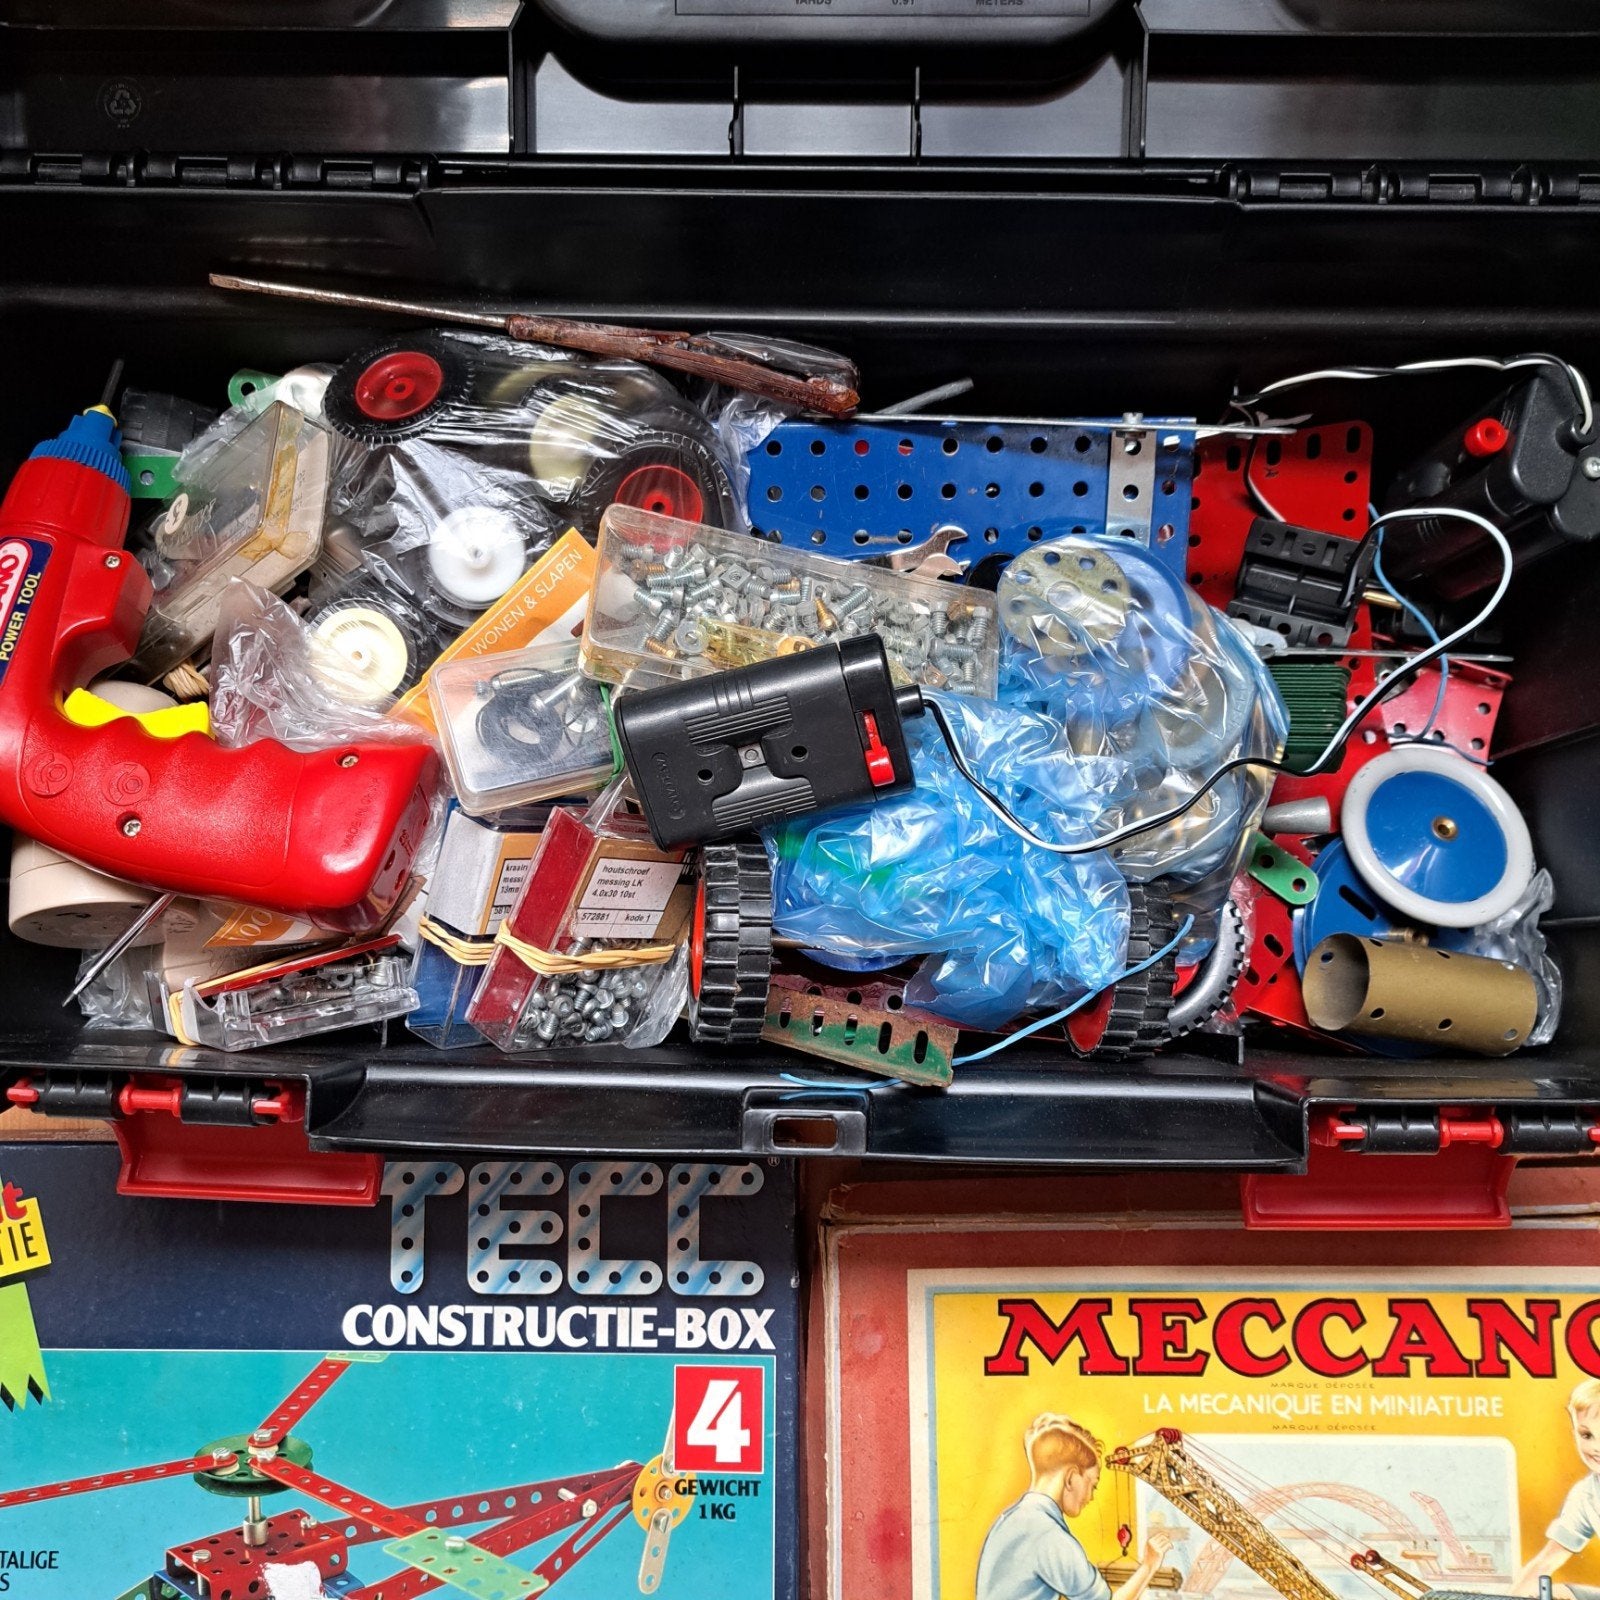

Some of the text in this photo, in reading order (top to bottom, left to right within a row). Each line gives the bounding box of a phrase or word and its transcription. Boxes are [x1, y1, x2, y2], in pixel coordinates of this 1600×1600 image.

[471, 548, 583, 655] WONEN & SLAPEN
[0, 571, 42, 661] POWER TOOL
[602, 865, 651, 876] houtschroef
[597, 878, 645, 888] messing LK
[620, 889, 636, 899] 10st
[625, 913, 644, 922] kode
[380, 1161, 765, 1296] TECC
[342, 1303, 776, 1350] CONSTRUCTIE-BOX
[1143, 1392, 1504, 1421] LA MECANIQUE EN MINIATURE
[687, 1380, 750, 1463] 4
[674, 1479, 762, 1497] GEWICHT
[699, 1503, 736, 1520] 1 KG
